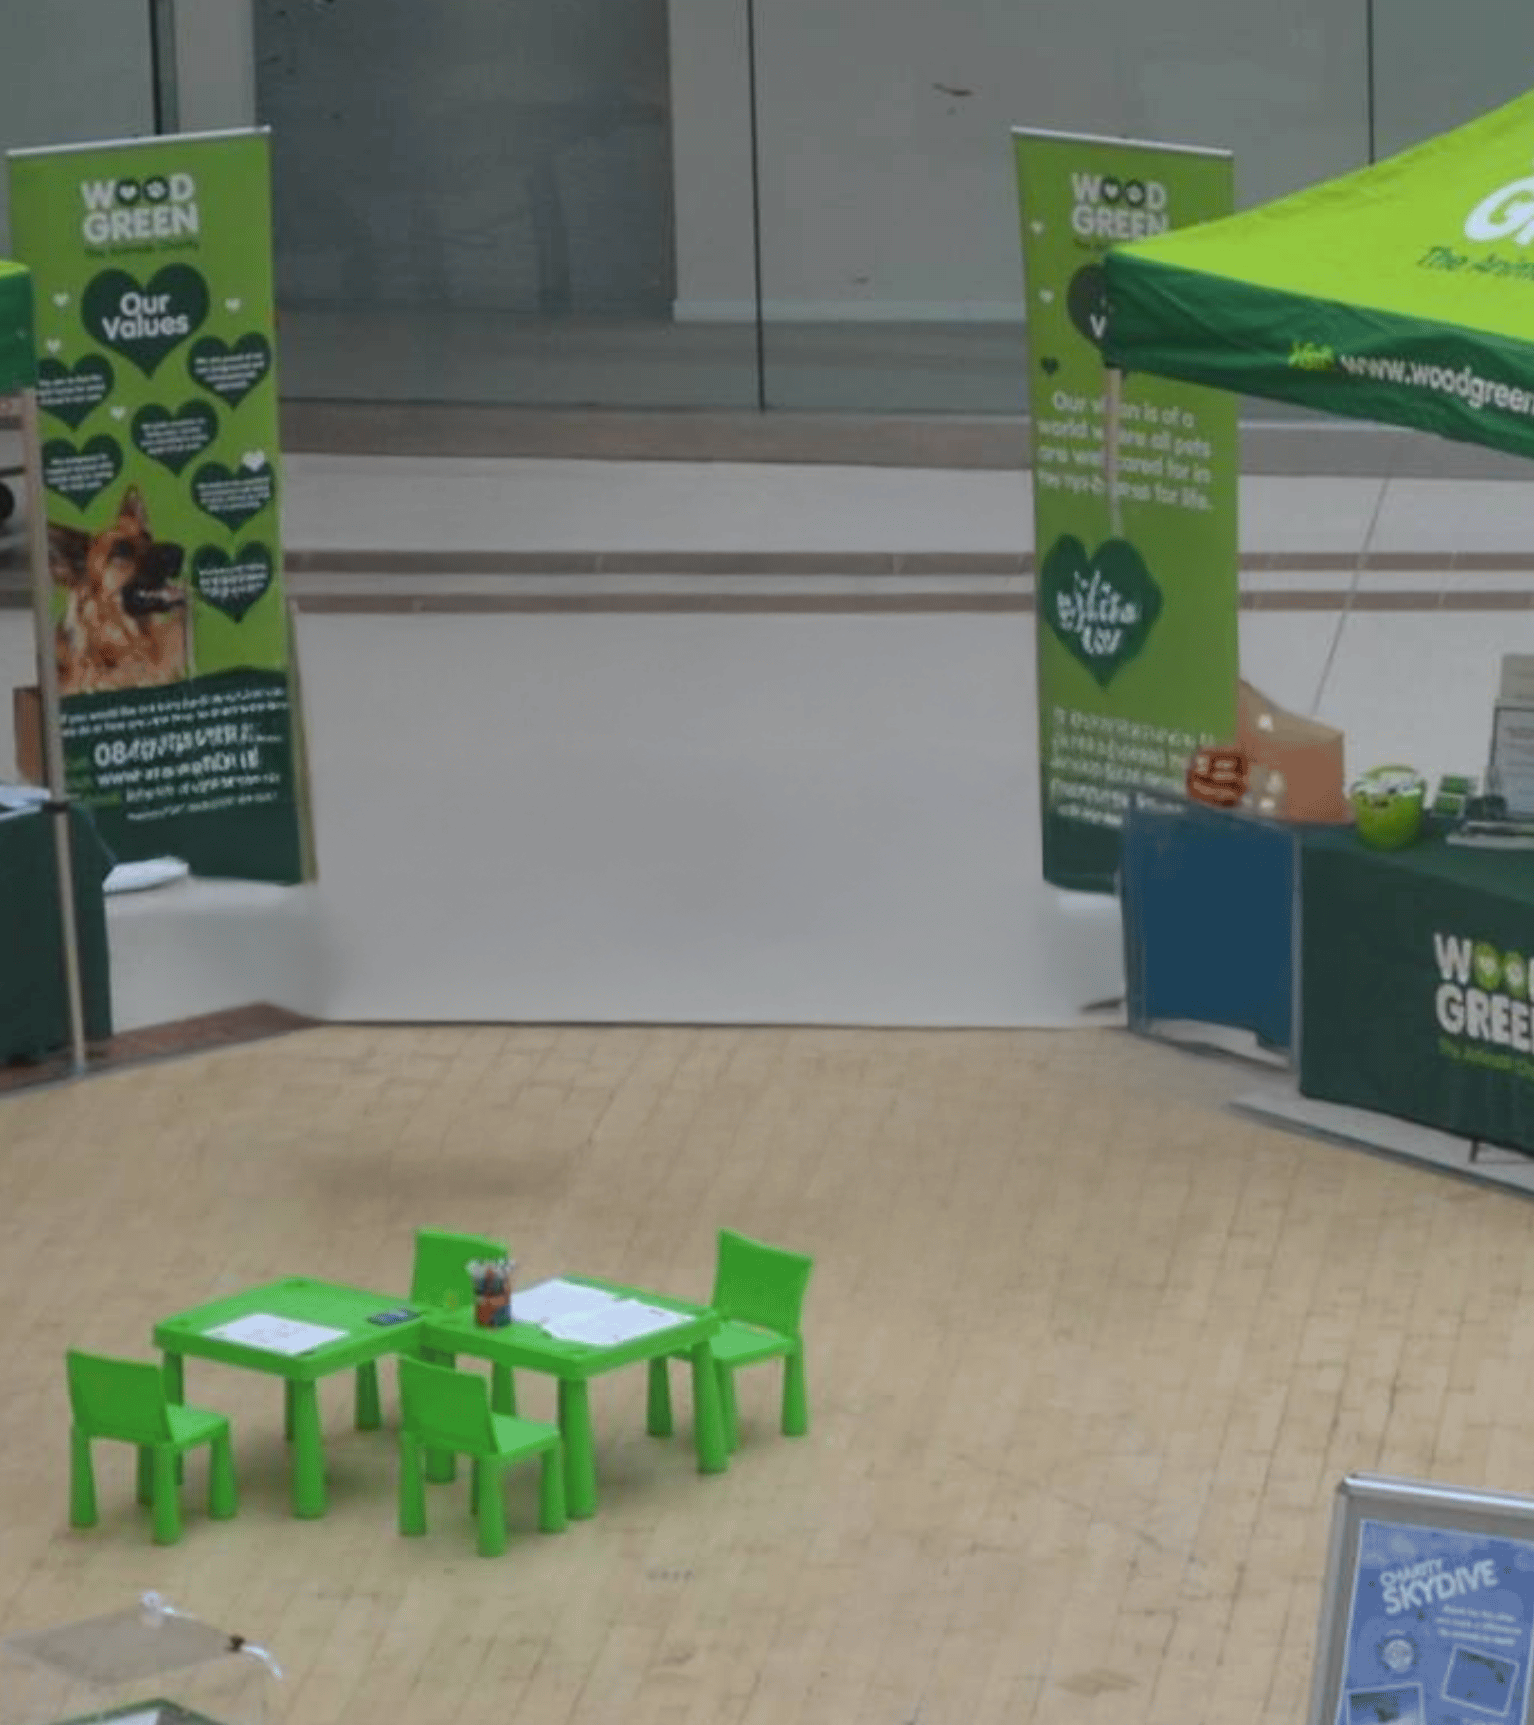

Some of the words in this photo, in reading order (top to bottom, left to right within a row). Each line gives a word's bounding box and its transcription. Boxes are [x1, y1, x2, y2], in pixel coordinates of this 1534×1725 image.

[81, 173, 194, 209] WOOD
[1072, 172, 1167, 210] WOOD
[82, 203, 199, 244] GREEN
[1072, 207, 1168, 241] GREEN
[119, 292, 171, 318] Our
[102, 313, 190, 341] Values
[1382, 1559, 1498, 1614] SKYDIVE
